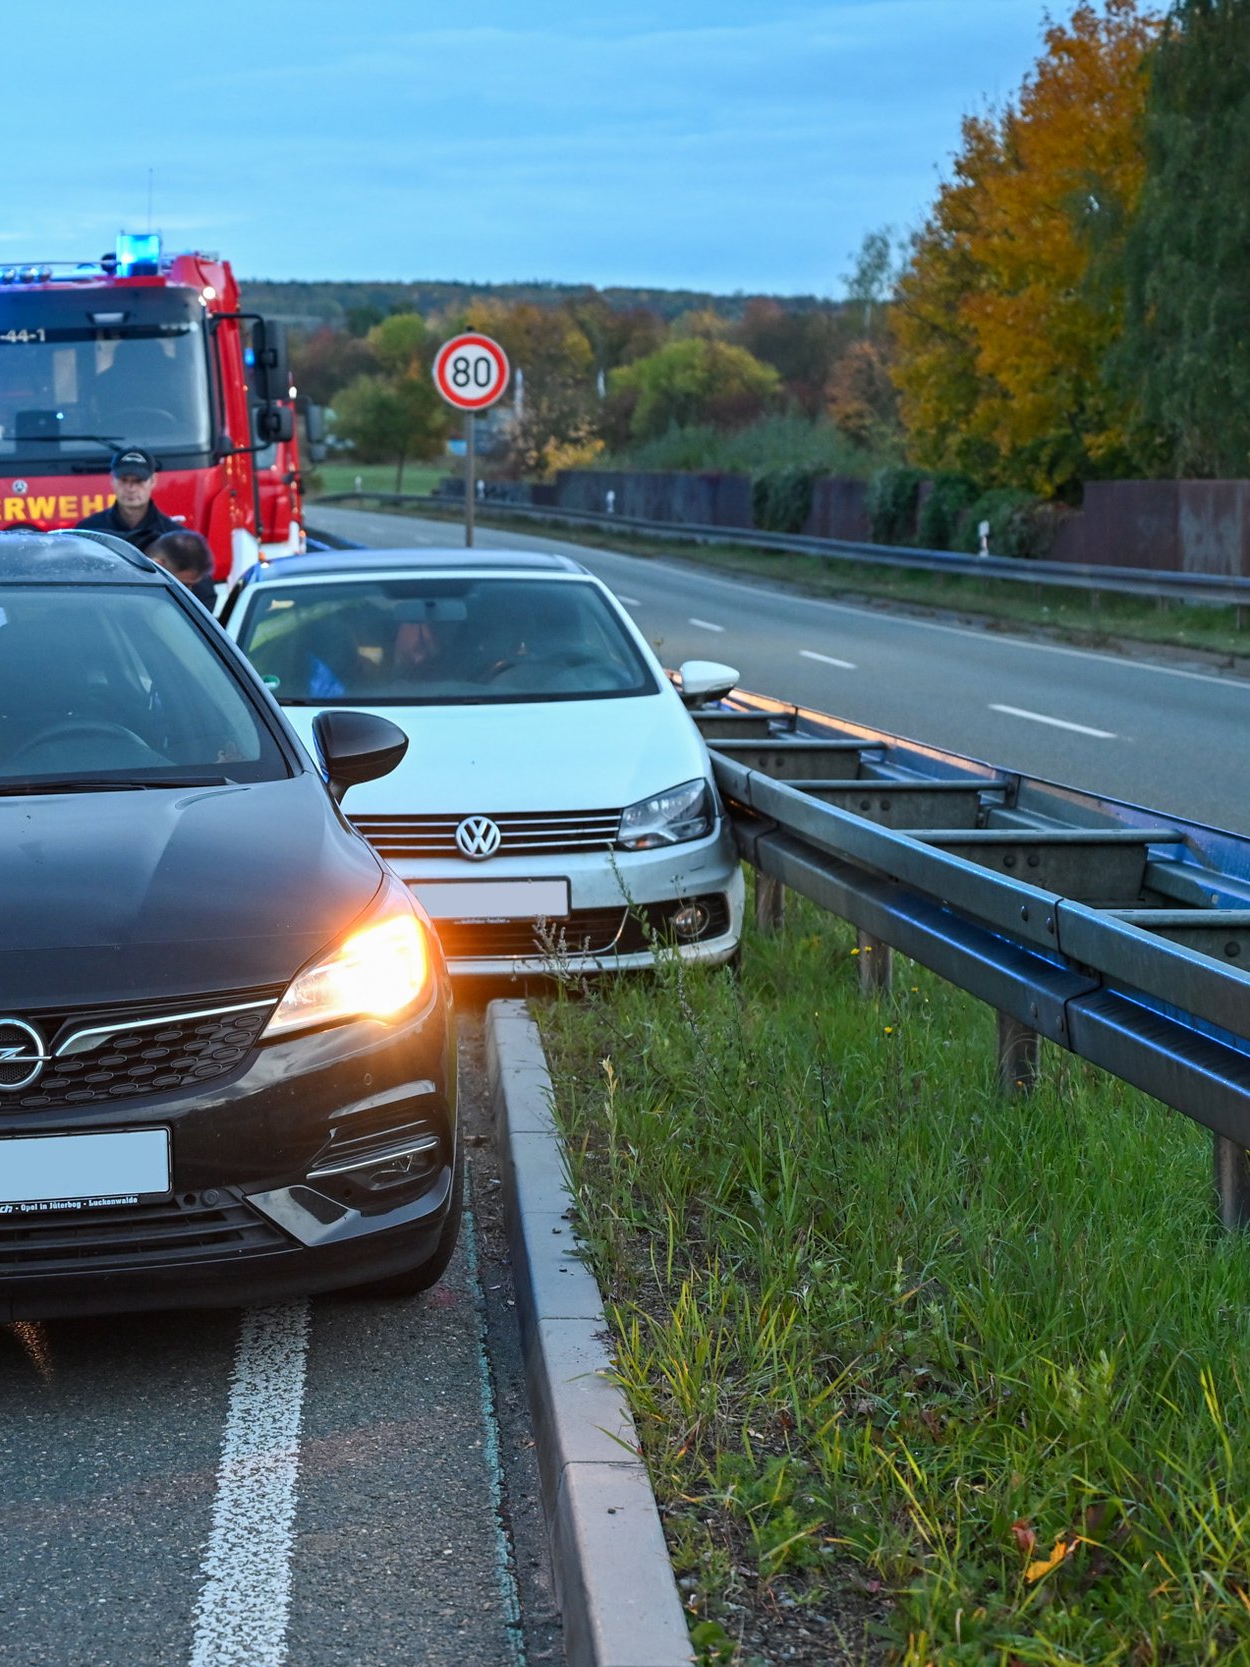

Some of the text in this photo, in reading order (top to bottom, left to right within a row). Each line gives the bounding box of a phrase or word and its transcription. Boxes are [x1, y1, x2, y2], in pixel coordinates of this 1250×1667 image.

[453, 356, 491, 388] 80
[21, 1202, 38, 1212] Opel
[40, 1202, 48, 1210] in
[49, 1200, 82, 1210] Jüterbog
[89, 1196, 138, 1207] Luckenwalde
